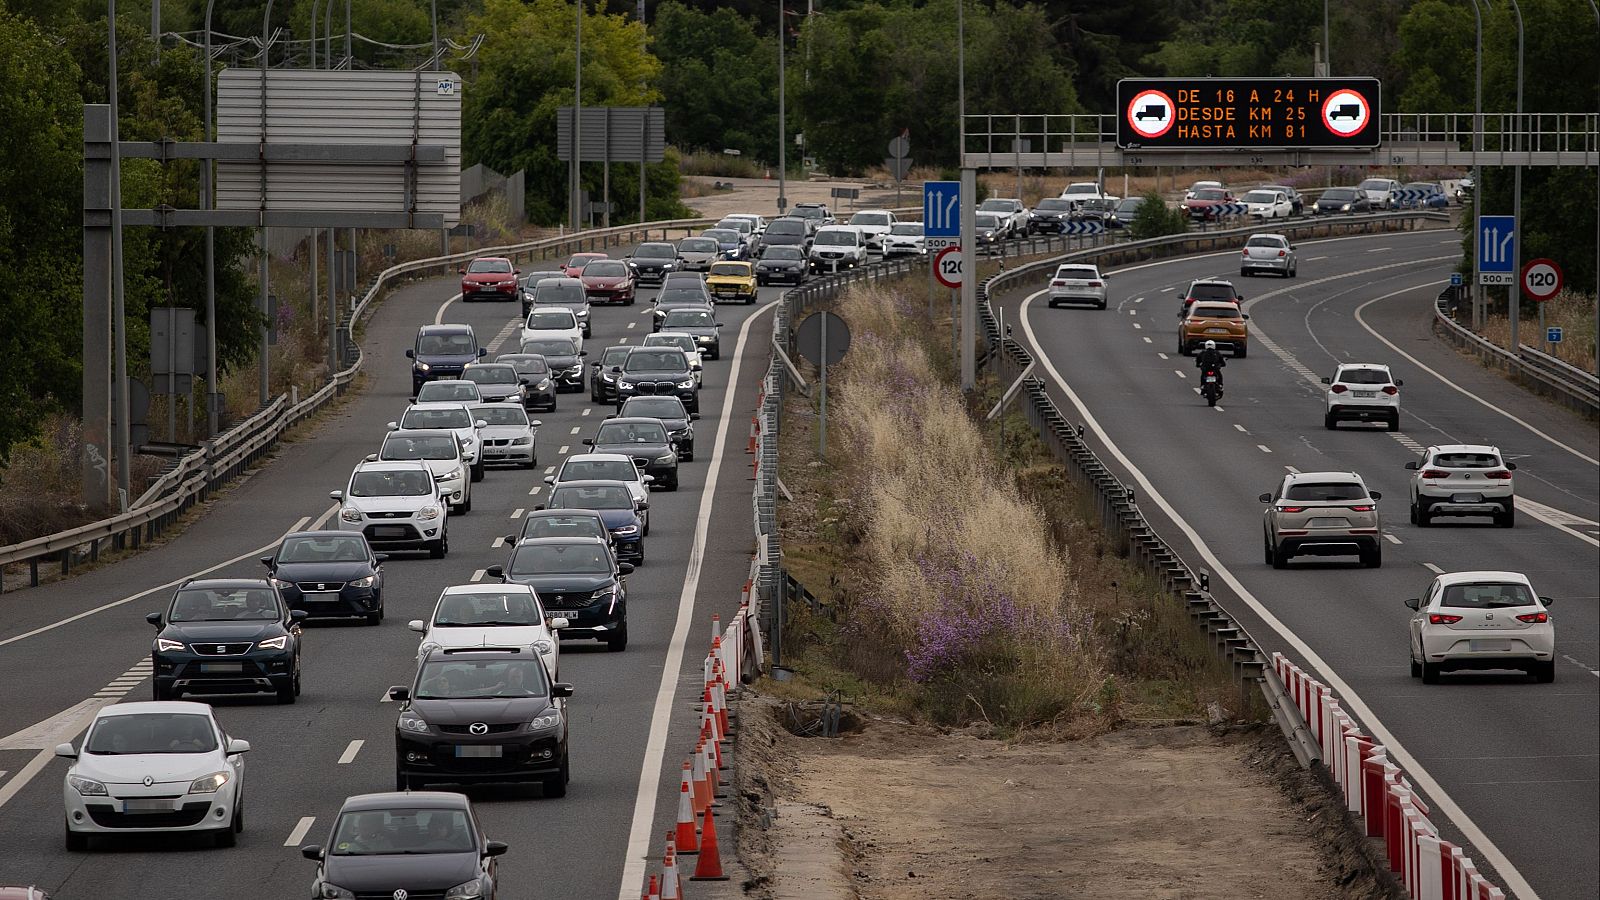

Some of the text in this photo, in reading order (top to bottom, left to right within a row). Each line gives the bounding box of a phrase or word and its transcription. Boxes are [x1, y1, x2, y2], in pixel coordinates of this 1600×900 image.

[1178, 90, 1319, 103] DE 16 A 24 H
[1178, 107, 1305, 120] DESDE KM 25
[1178, 125, 1305, 138] HASTA KM 81
[1528, 273, 1555, 286] 120
